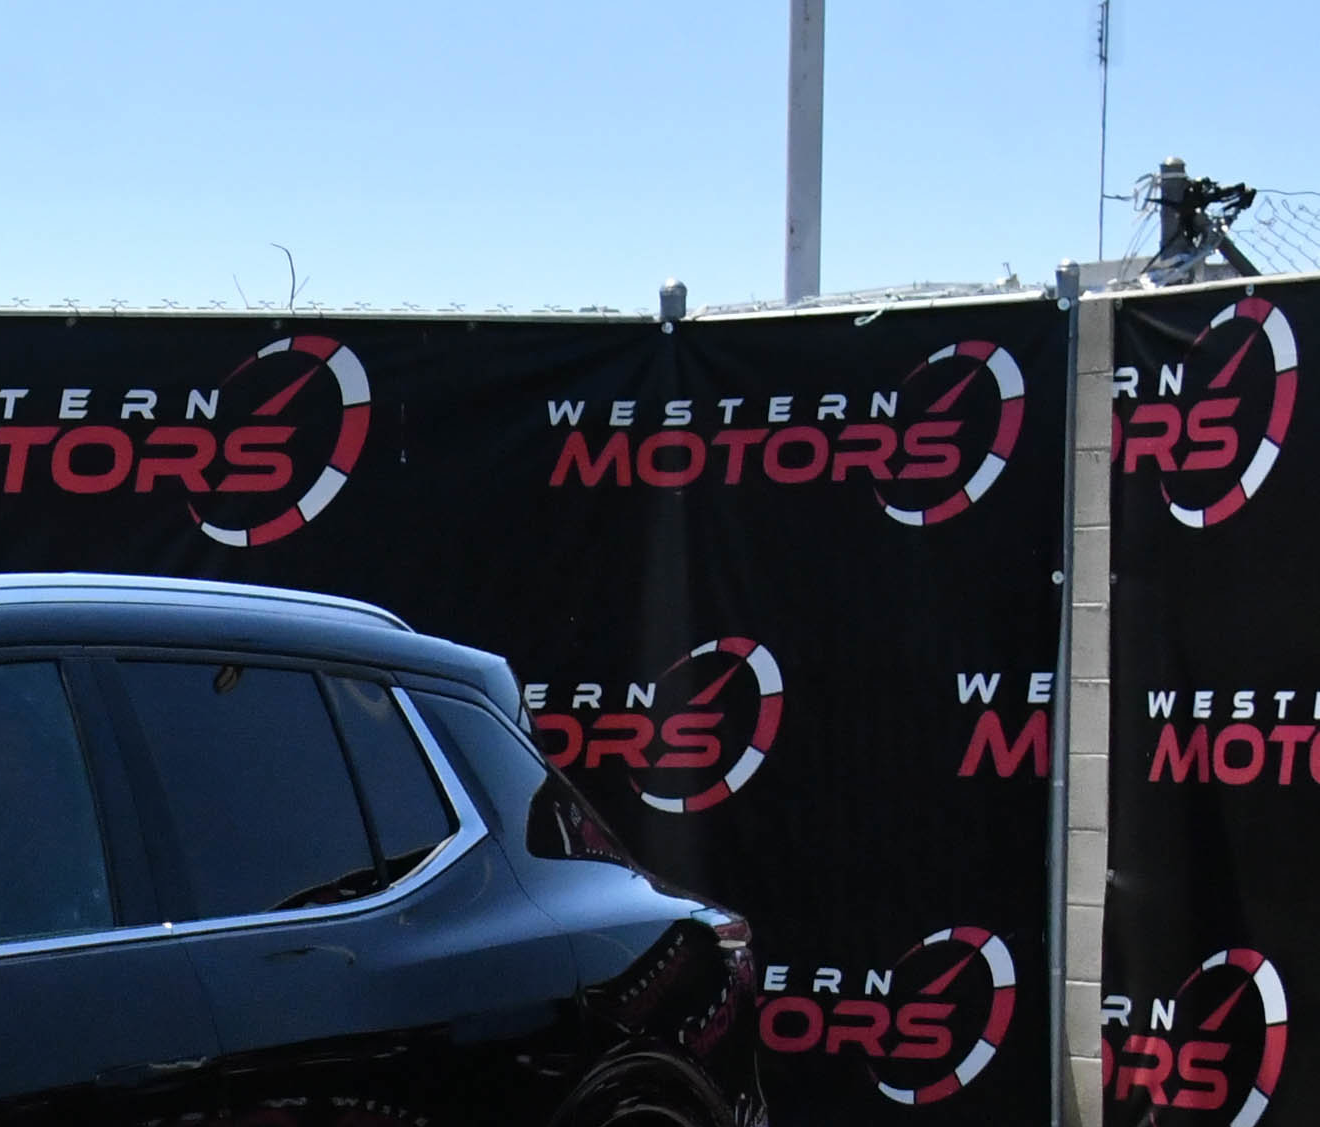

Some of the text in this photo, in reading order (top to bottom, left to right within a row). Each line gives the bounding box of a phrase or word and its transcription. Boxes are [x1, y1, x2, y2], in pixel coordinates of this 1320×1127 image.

[548, 391, 898, 426] WESTERN
[550, 421, 963, 487] MOTORS
[1147, 690, 1320, 720] WEST
[536, 712, 724, 768] ORS
[1148, 722, 1320, 785] MOT
[756, 995, 956, 1059] ORS
